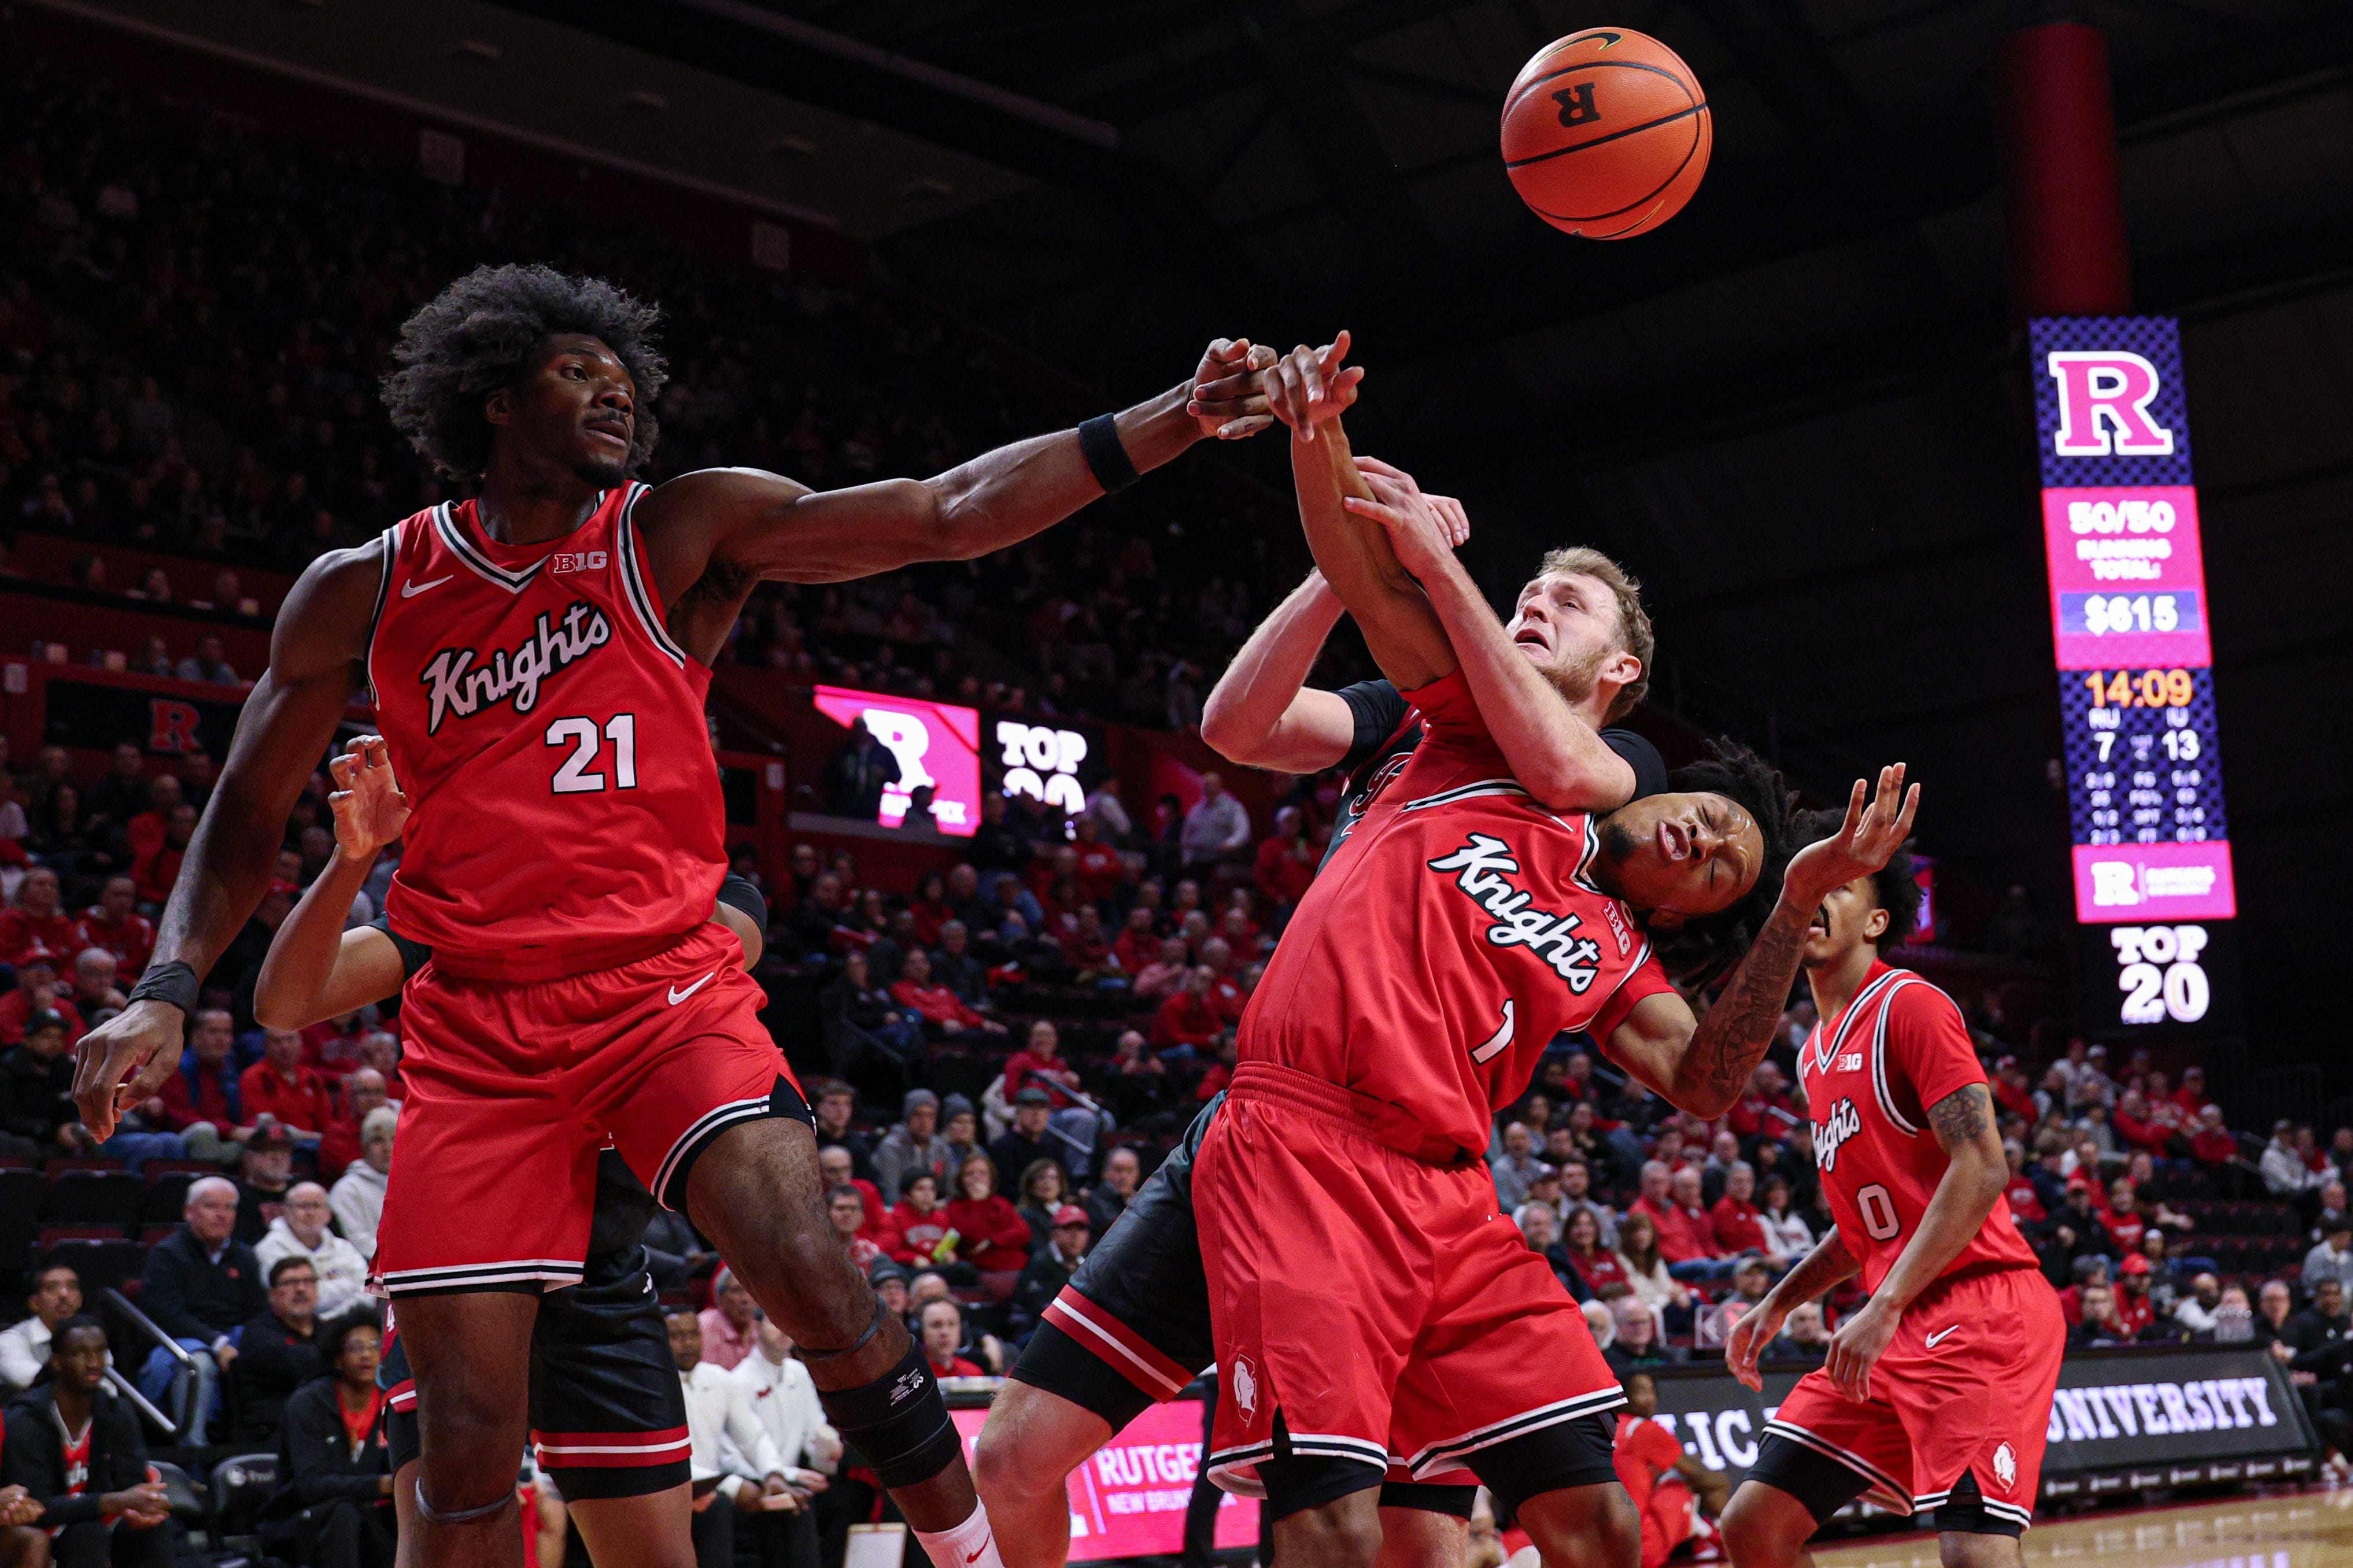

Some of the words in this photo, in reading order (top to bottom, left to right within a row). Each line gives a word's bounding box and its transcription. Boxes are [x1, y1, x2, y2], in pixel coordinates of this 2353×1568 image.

[1551, 82, 1602, 127] R
[2048, 350, 2174, 457] R
[2068, 500, 2176, 534] 50/50
[2084, 594, 2179, 637] $615
[420, 599, 612, 737] Knights
[2085, 668, 2193, 709] 14:09
[150, 697, 202, 753] R
[996, 720, 1088, 775] TOP
[2093, 731, 2116, 763] 7
[2162, 729, 2201, 761] 13
[545, 713, 637, 795] 21
[2090, 861, 2140, 907] R
[1427, 831, 1602, 995] Knights
[2111, 925, 2208, 965] TOP
[2118, 961, 2210, 1025] 20
[1469, 998, 1515, 1064] 1
[1811, 1097, 1861, 1174] ights
[1857, 1182, 1901, 1241] 0
